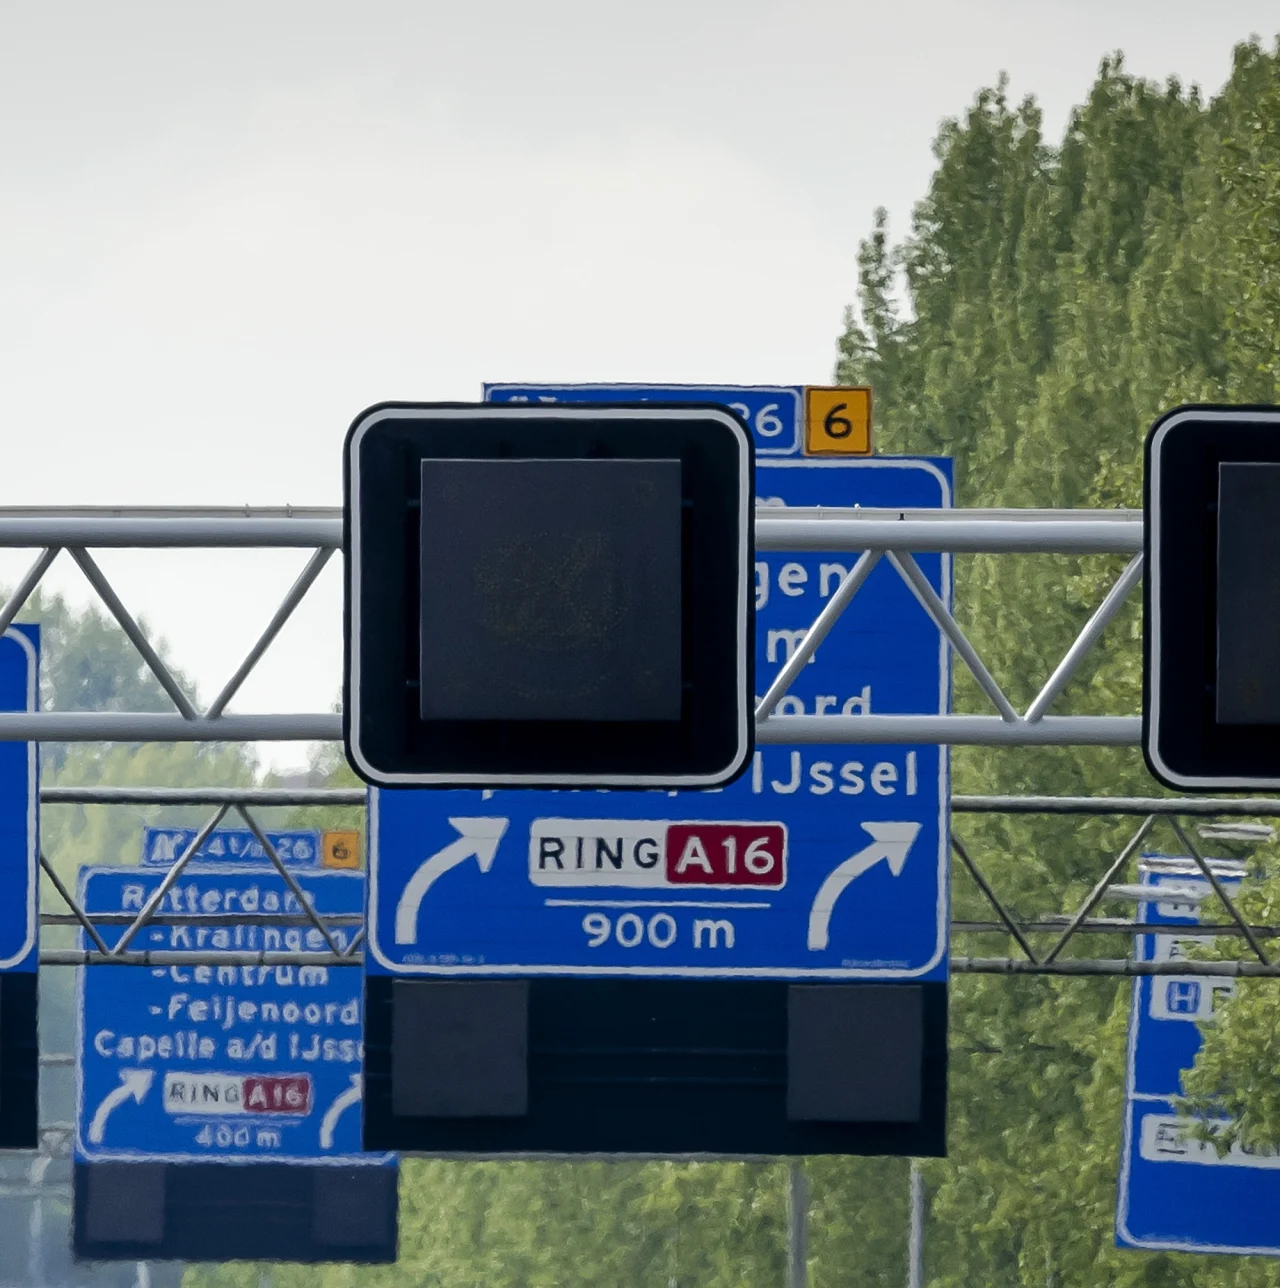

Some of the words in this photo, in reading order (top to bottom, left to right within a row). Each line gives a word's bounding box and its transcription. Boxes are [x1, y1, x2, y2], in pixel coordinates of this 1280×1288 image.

[824, 402, 852, 439] 6
[752, 751, 918, 796] IJssel
[538, 836, 659, 871] RING
[673, 836, 775, 874] A16
[582, 913, 677, 948] 900
[692, 918, 736, 949] m
[94, 1029, 216, 1064] Capelle
[169, 1081, 240, 1104] RING
[248, 1084, 304, 1107] A16
[195, 1124, 249, 1147] 400
[256, 1130, 282, 1148] m
